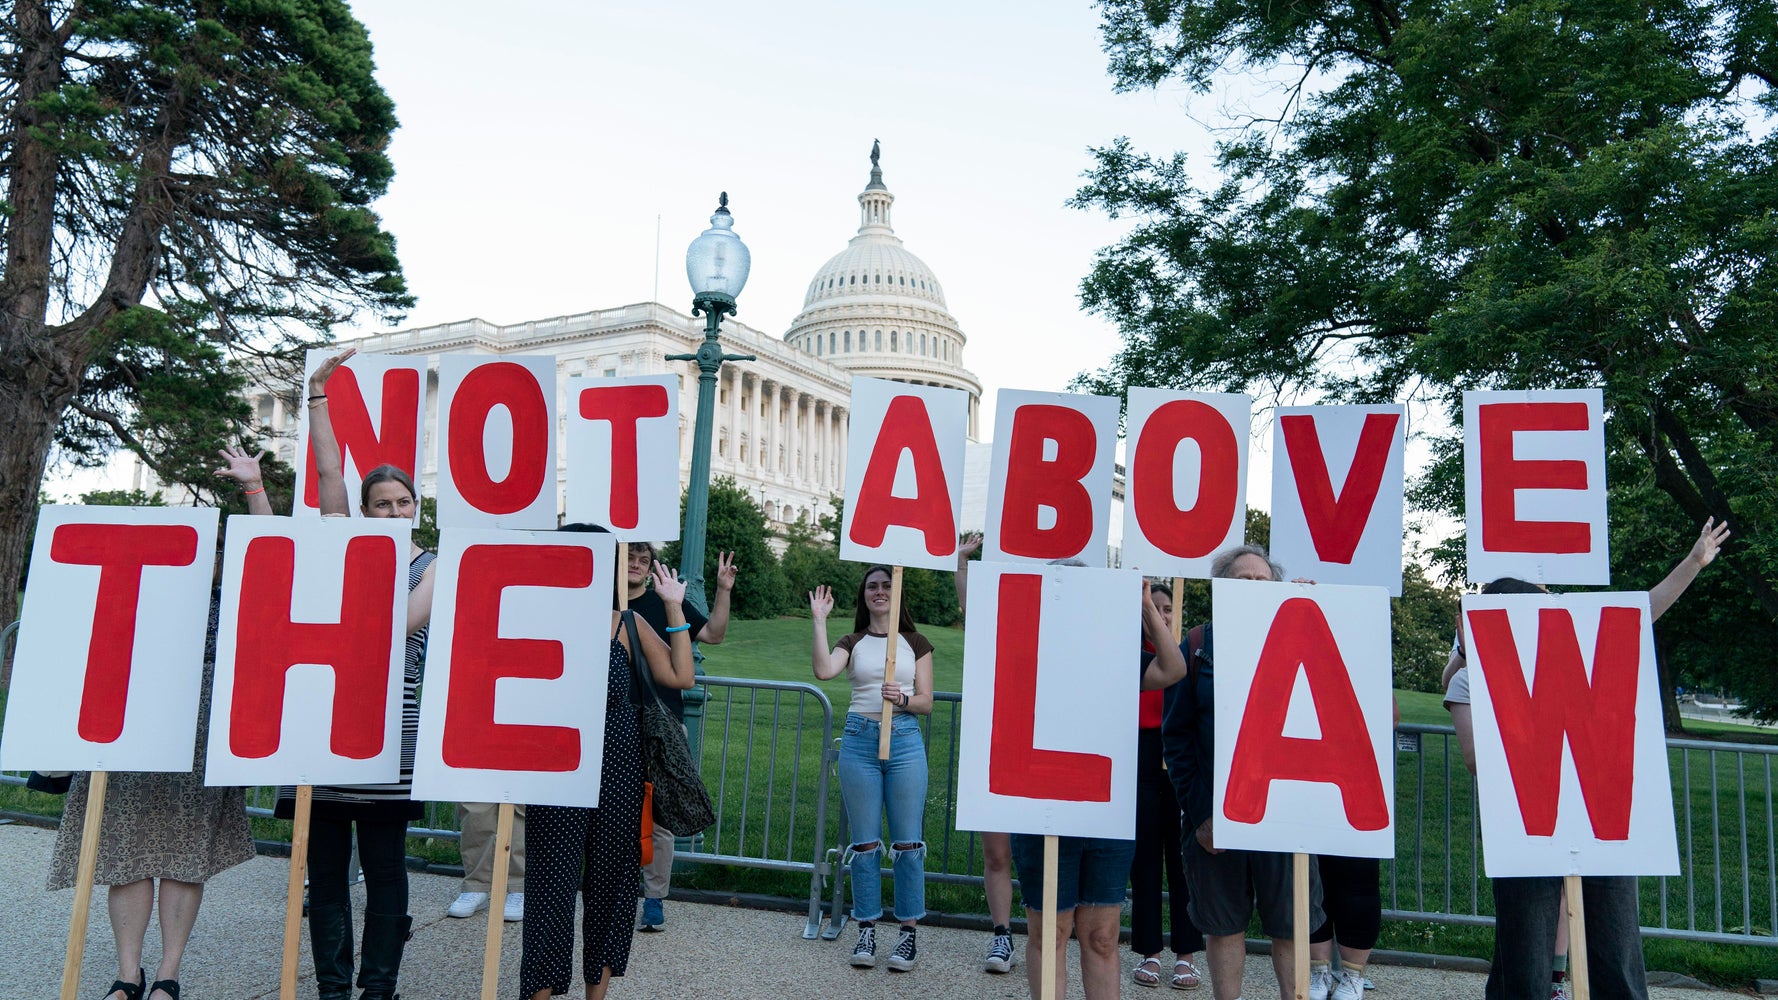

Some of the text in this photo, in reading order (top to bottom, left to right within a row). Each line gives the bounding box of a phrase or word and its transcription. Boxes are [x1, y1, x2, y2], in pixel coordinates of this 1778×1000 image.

[304, 361, 1591, 564] NOT ABOVE
[50, 523, 1641, 841] THE LAW
